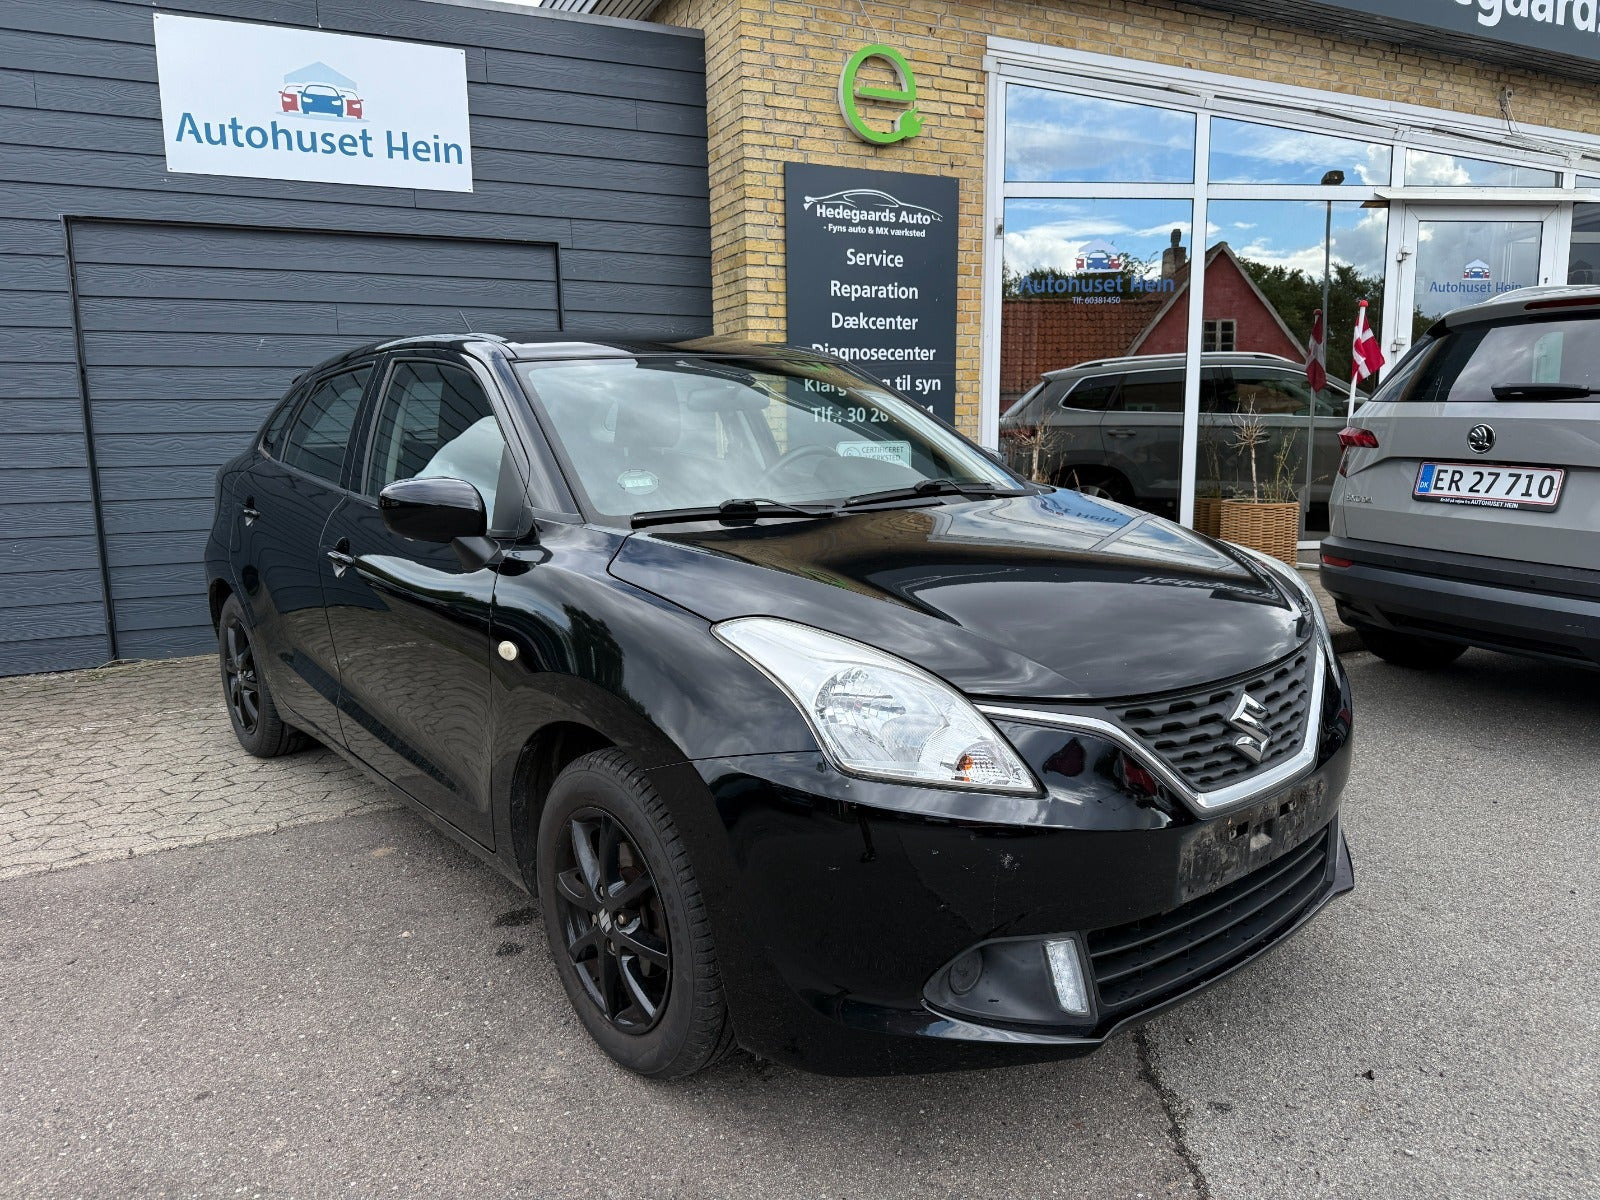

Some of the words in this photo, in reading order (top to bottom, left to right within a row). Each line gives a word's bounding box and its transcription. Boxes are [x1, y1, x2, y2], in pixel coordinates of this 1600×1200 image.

[176, 112, 373, 158] Autohuset
[386, 130, 463, 165] Hein
[816, 204, 896, 223] Hedegaards
[899, 211, 931, 225] Auto
[828, 224, 847, 234] Fyns
[848, 226, 867, 234] auto
[876, 227, 889, 235] MX
[890, 228, 926, 238] værksted
[846, 249, 904, 268] Service
[830, 280, 919, 301] Reparation
[1018, 275, 1123, 294] Autohuset
[1130, 275, 1175, 294] Hein
[1429, 281, 1492, 294] Autohuset
[1084, 296, 1121, 305] 60381450
[831, 312, 919, 331] Dækcenter
[895, 374, 911, 389] til
[915, 378, 942, 395] syn
[811, 406, 842, 423] Tlf.:
[847, 407, 867, 423] 30
[870, 407, 889, 423] 26
[861, 446, 904, 454] CERTIFICERET
[1433, 469, 1464, 492] ER
[1468, 471, 1500, 494] 27
[1504, 473, 1556, 499] 710
[1471, 499, 1503, 508] AUTOHUSET
